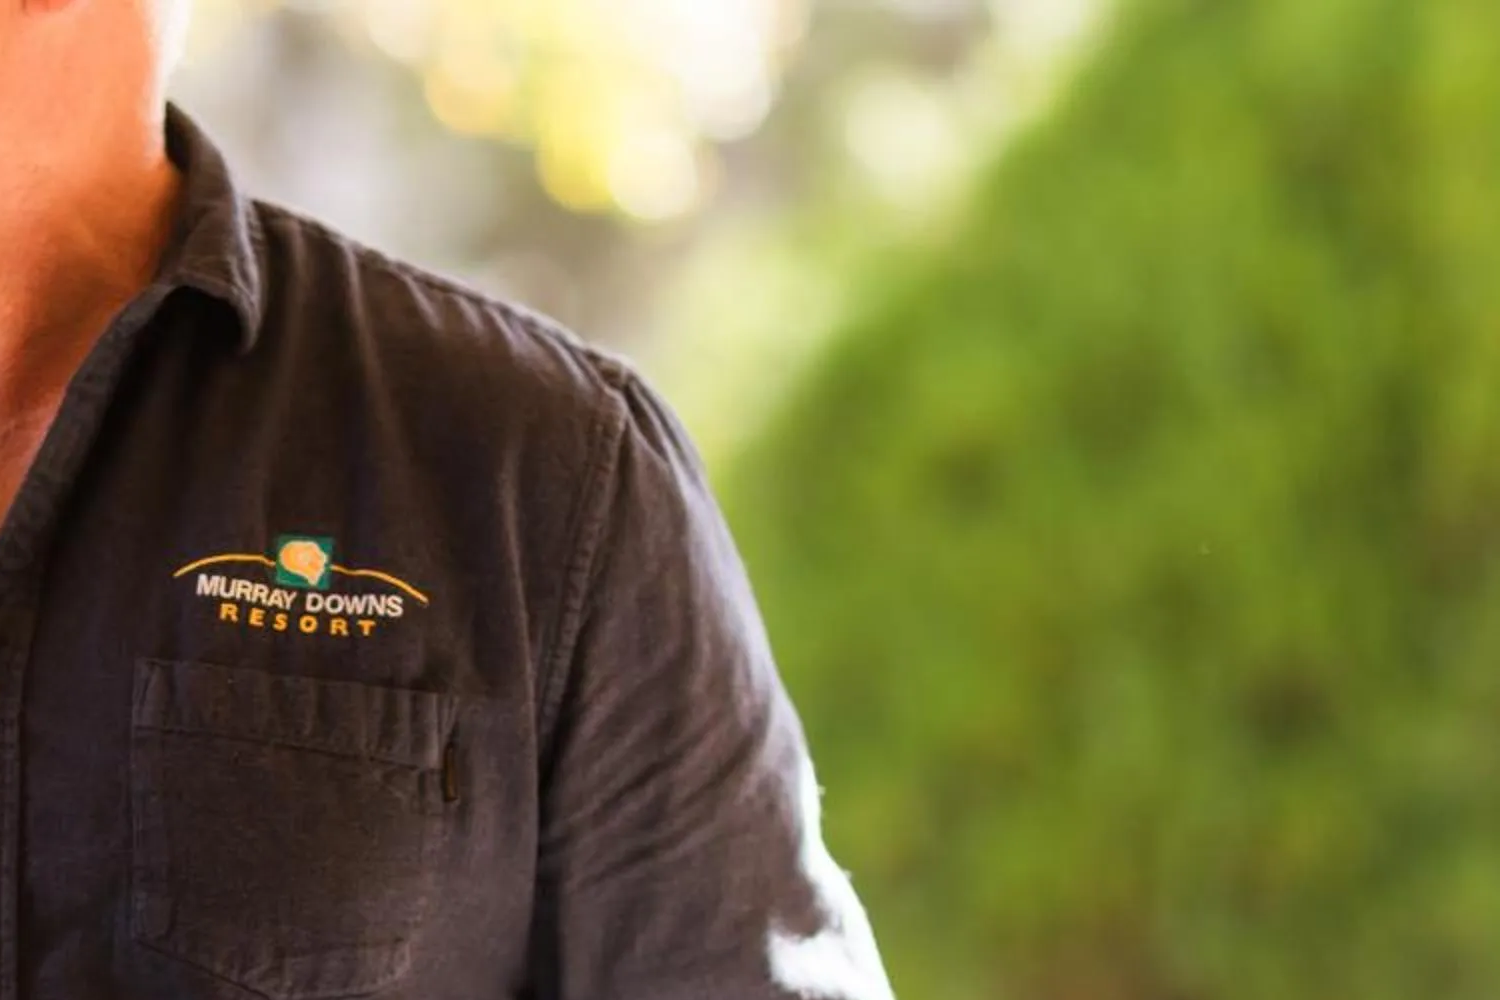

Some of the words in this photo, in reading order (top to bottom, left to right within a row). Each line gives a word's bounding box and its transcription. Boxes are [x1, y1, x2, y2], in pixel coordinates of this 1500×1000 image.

[196, 573, 296, 610] MURRAY
[306, 592, 403, 617] DOWNS
[220, 603, 376, 635] RESORT
